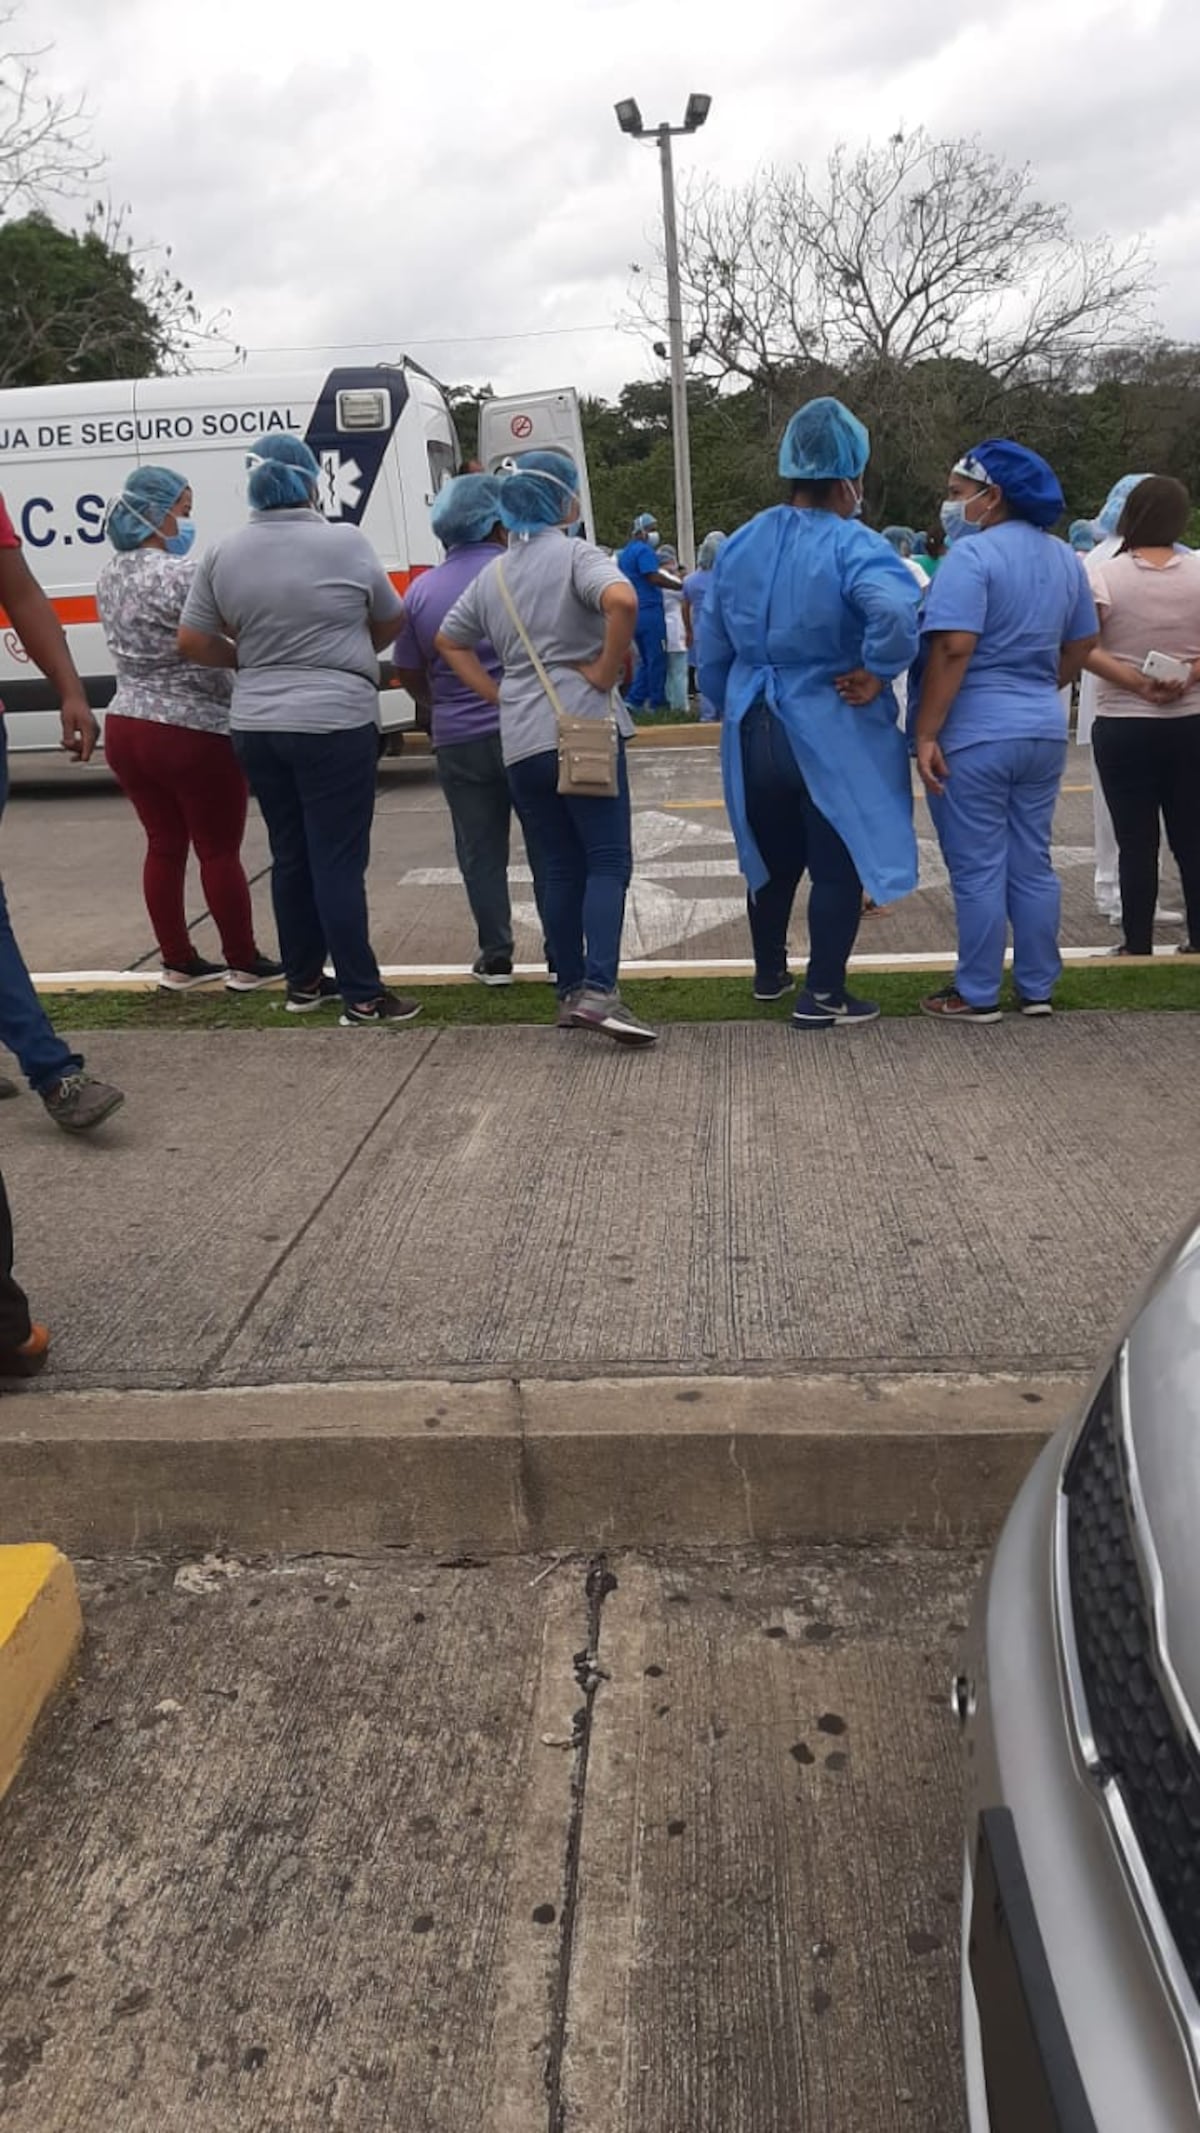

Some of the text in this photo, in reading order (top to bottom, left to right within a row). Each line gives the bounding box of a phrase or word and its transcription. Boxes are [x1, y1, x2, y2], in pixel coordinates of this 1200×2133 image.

[38, 425, 72, 447] DE
[82, 416, 193, 444] SEGURO
[202, 409, 300, 435] SOCIAL
